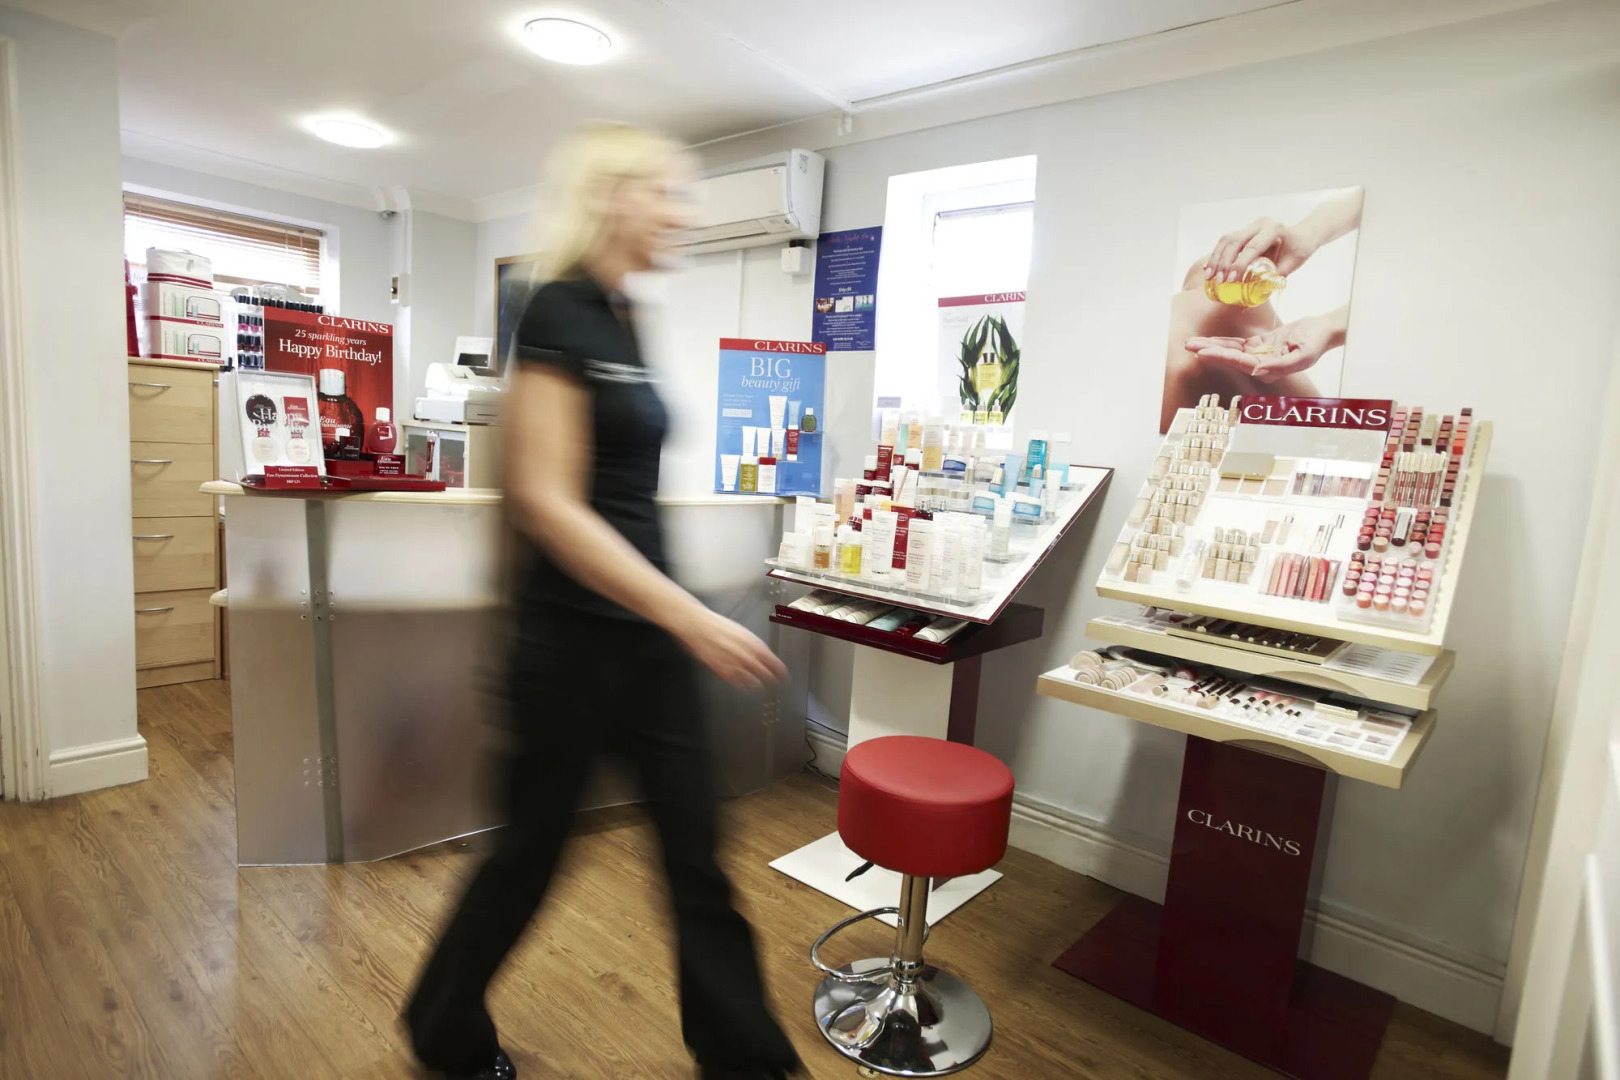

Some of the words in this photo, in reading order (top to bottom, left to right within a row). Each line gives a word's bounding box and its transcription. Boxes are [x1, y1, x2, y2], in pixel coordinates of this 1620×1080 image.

[984, 292, 1025, 302] CLARIN
[318, 315, 389, 334] CLARINS
[295, 329, 306, 338] 25
[308, 332, 345, 344] sparkling
[346, 337, 366, 346] years
[279, 338, 323, 359] Happy
[325, 344, 382, 365] Birthday!
[754, 341, 823, 354] CLARINS
[751, 357, 791, 378] BIG
[741, 376, 780, 392] beauty
[782, 378, 801, 392] gift
[1243, 404, 1387, 426] CLARINS
[1187, 809, 1301, 856] CLARINS
